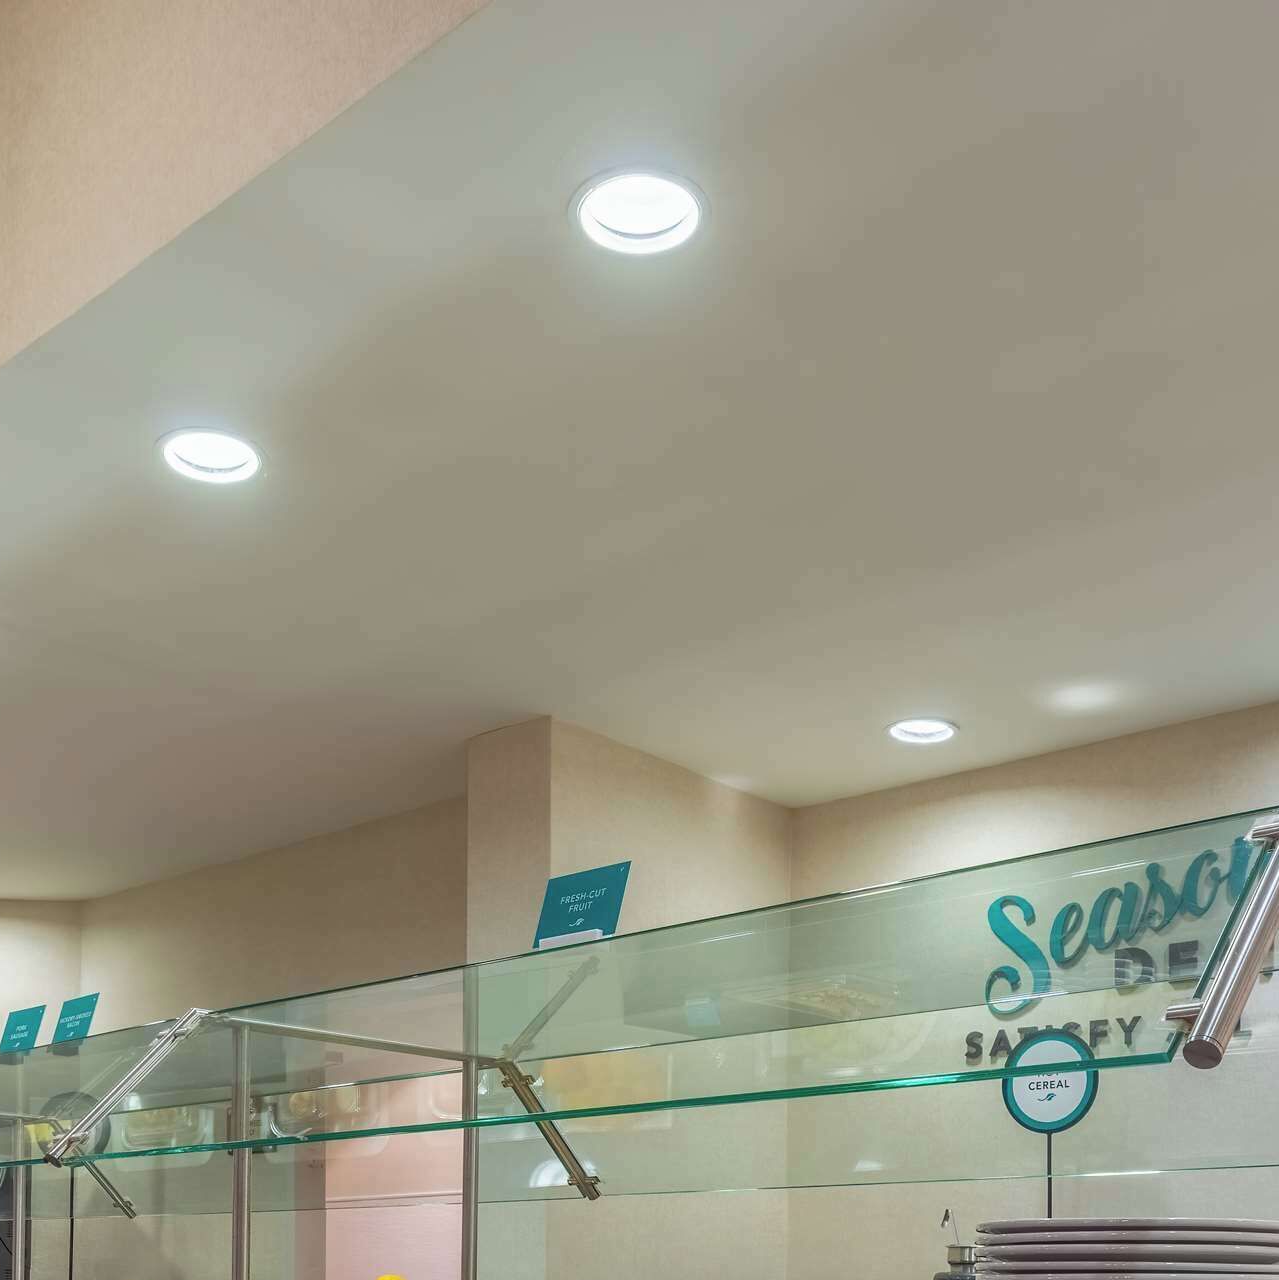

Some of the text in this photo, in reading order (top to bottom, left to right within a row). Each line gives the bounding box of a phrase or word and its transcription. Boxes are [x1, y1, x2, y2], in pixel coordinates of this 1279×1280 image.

[560, 887, 607, 905] FRESH-CUT
[568, 901, 593, 913] FRUIT
[1028, 1079, 1070, 1091] CEREAL
